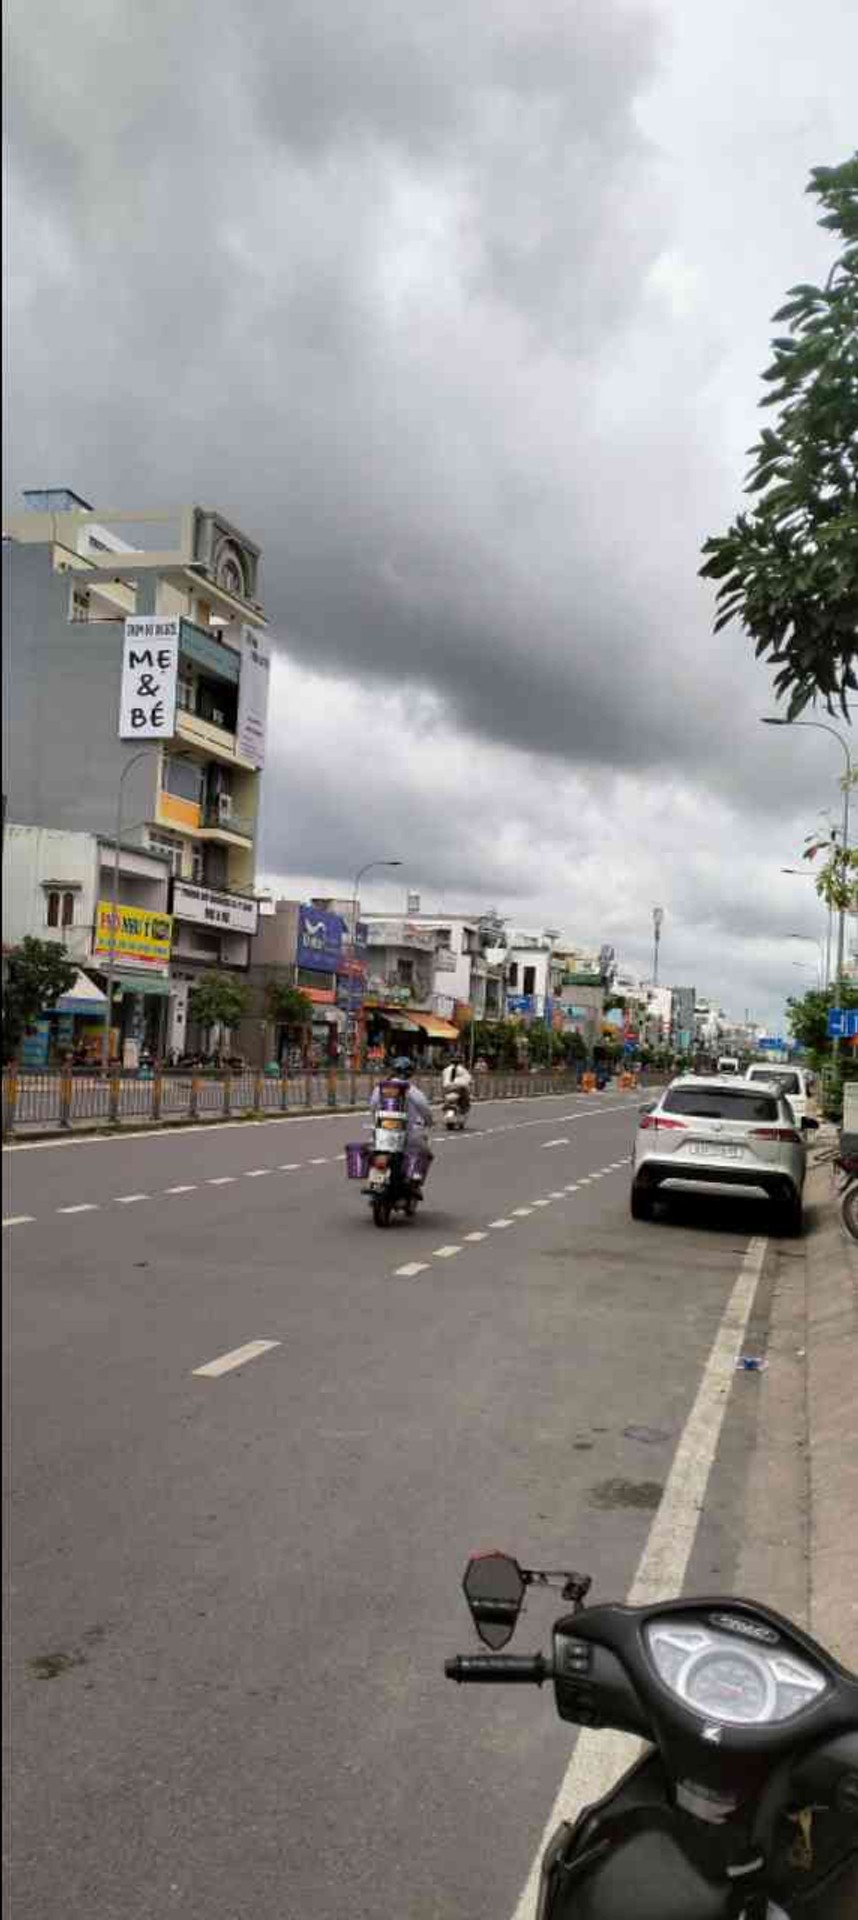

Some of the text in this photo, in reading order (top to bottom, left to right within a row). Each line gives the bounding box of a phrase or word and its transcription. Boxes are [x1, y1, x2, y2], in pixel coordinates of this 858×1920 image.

[129, 649, 171, 674] MẸ
[137, 674, 160, 697] &
[131, 701, 166, 728] BÉ
